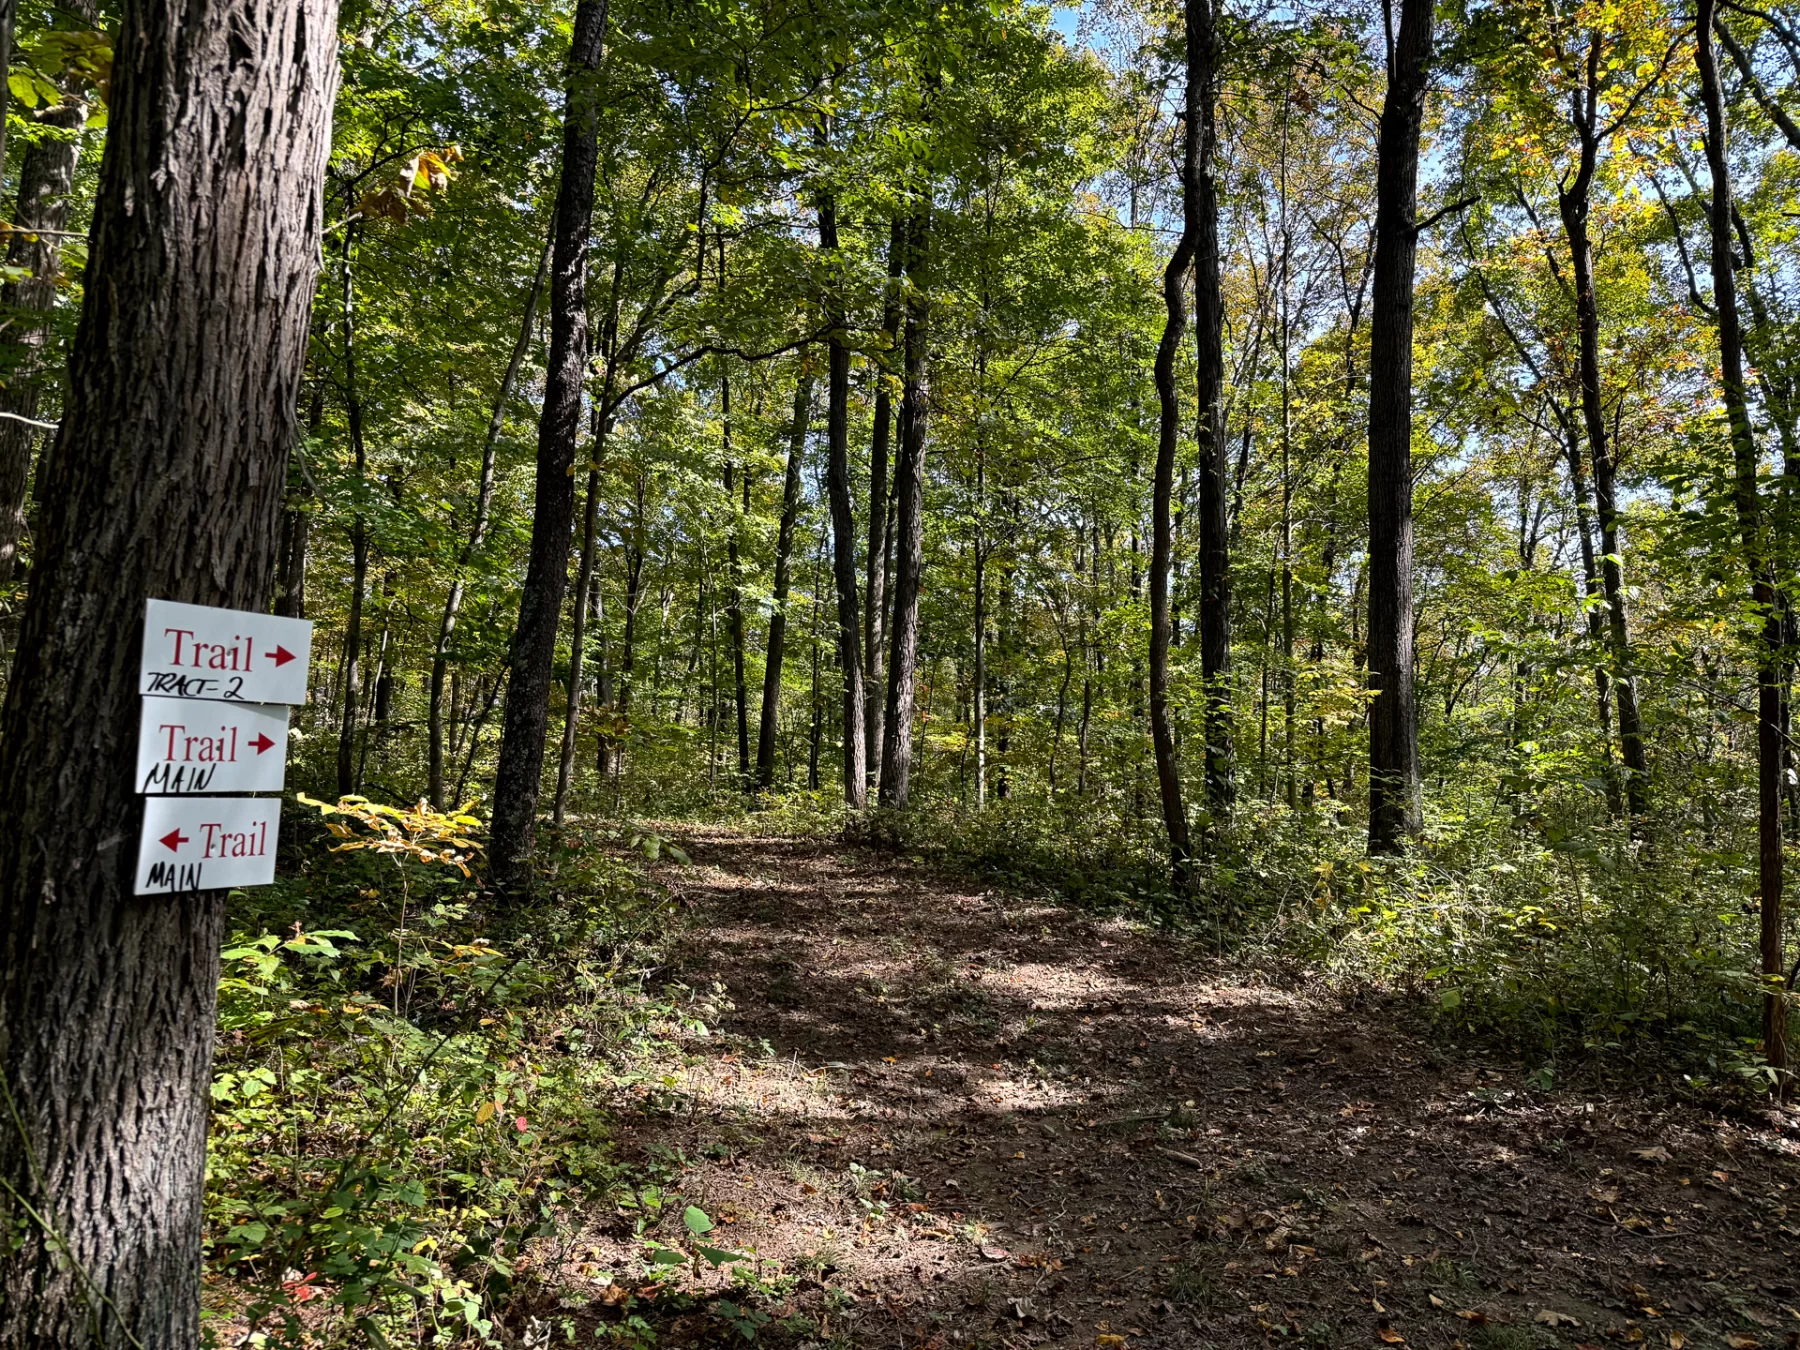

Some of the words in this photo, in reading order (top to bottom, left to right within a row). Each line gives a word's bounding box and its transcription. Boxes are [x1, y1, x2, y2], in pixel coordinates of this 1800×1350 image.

[164, 629, 253, 672] Trail
[159, 725, 238, 762] Trail
[144, 763, 216, 793] MAIN
[199, 821, 266, 858] Trail
[145, 861, 203, 892] MAIN
